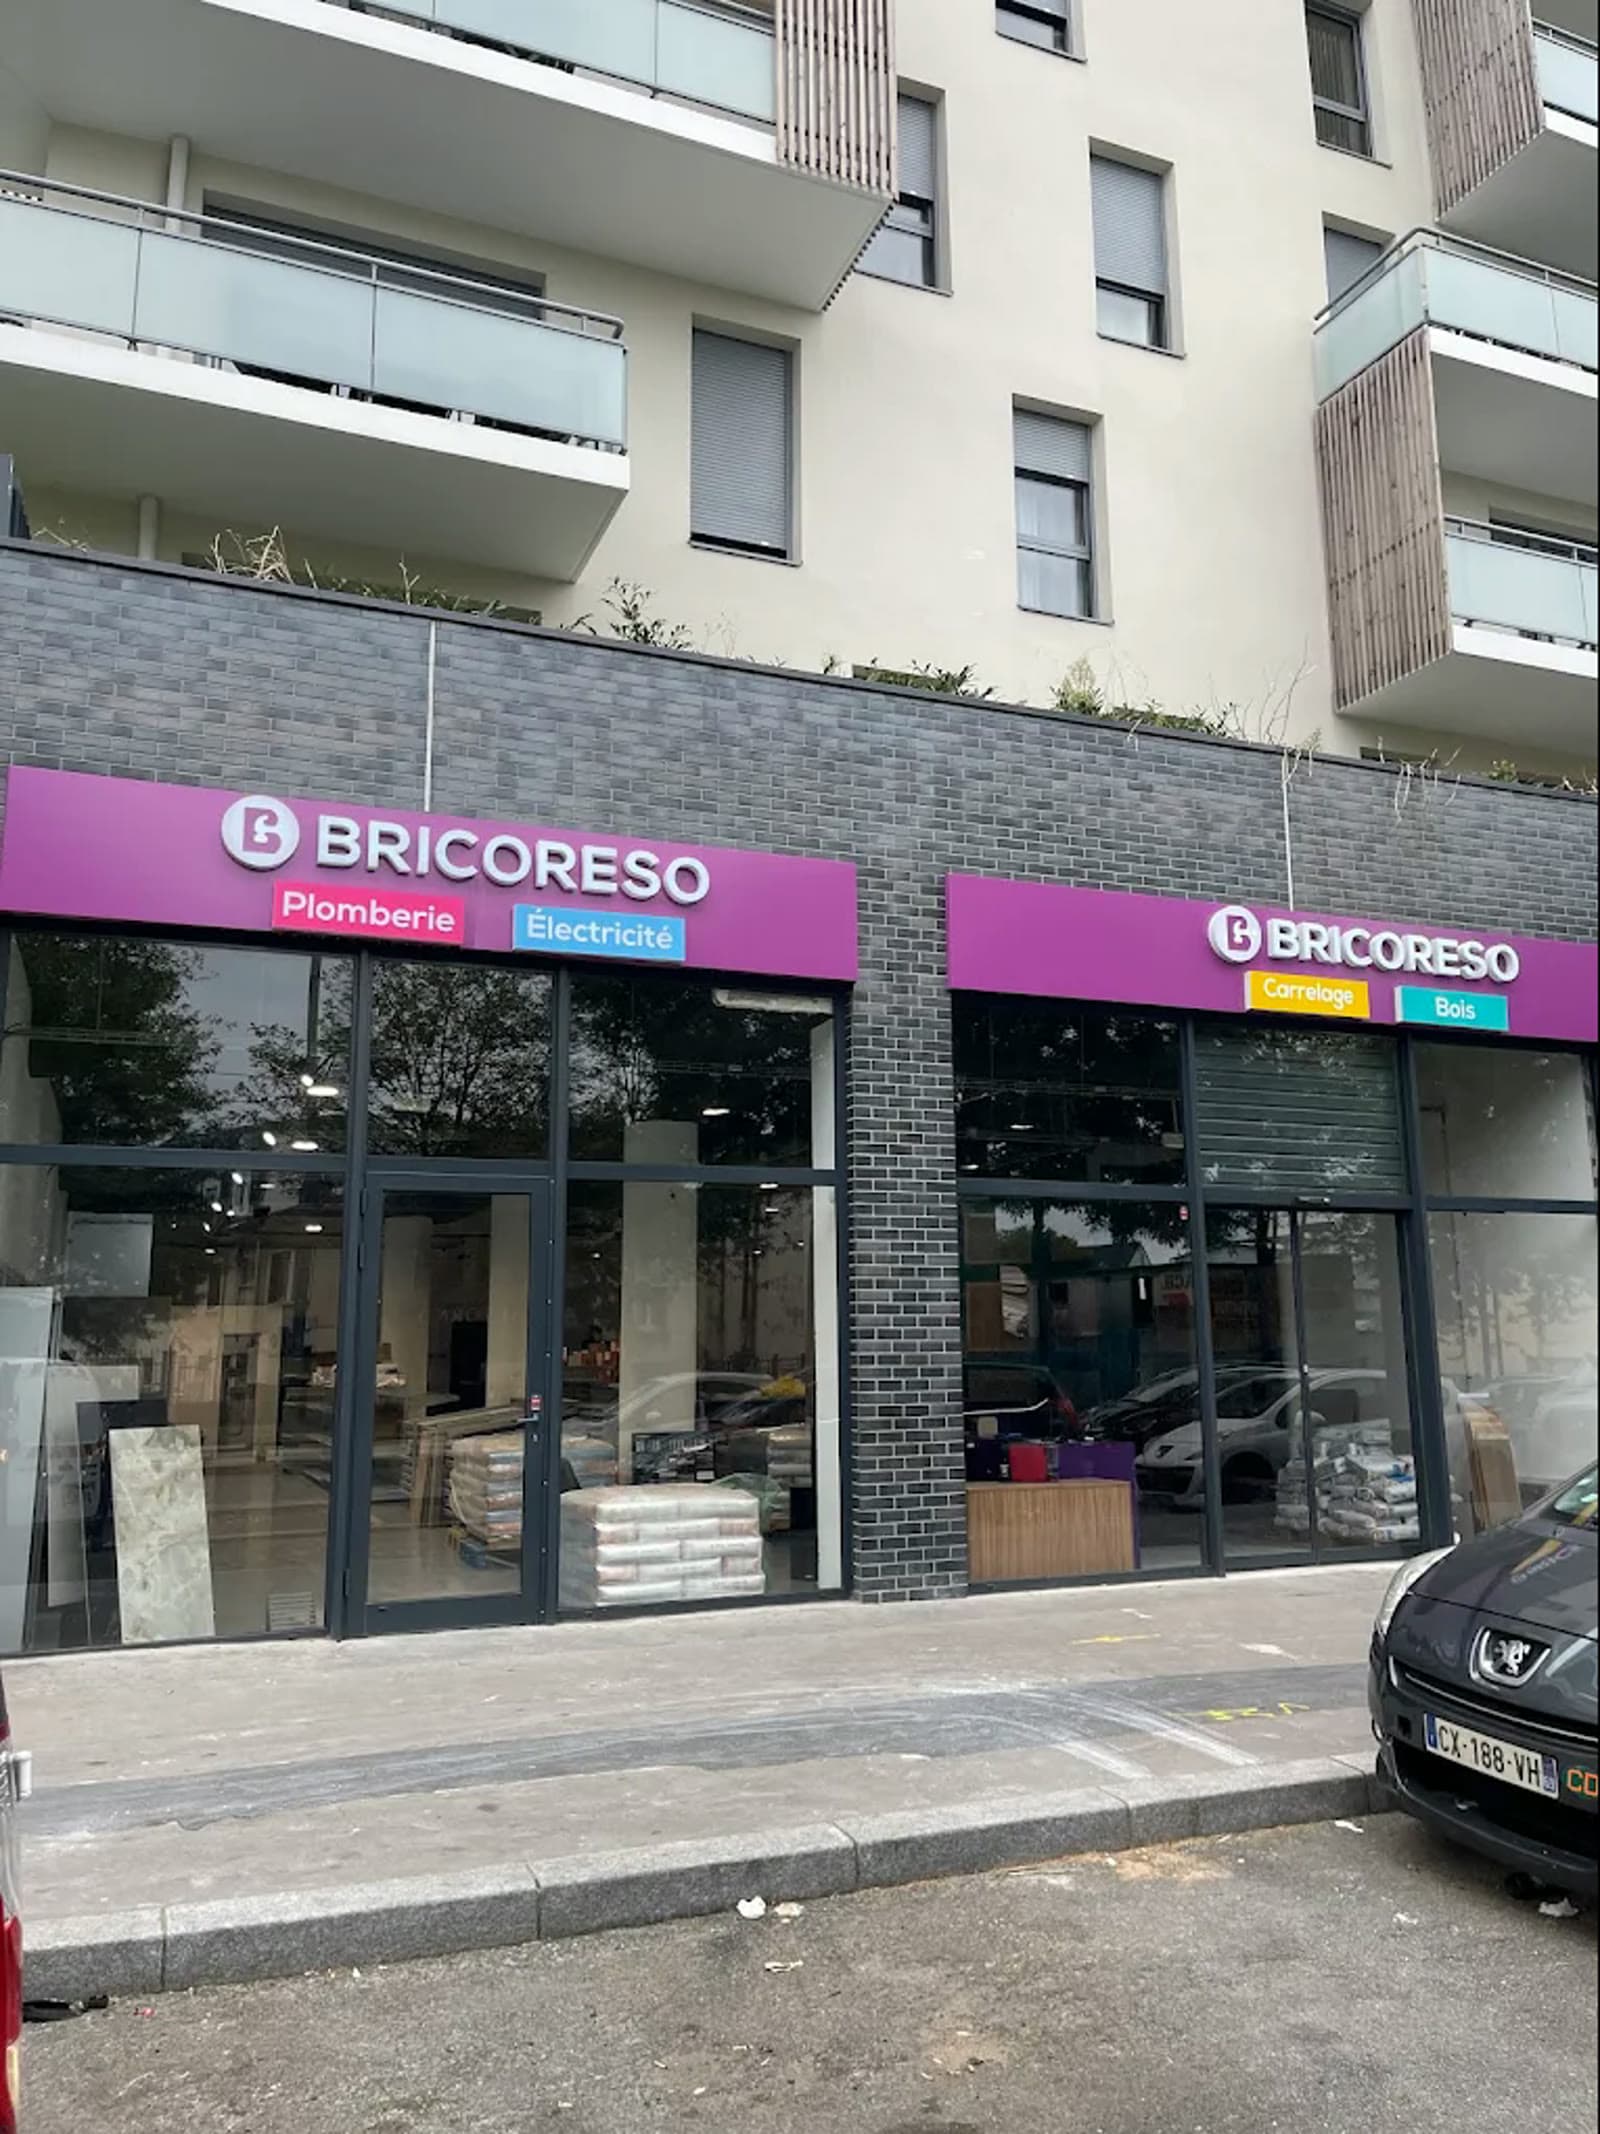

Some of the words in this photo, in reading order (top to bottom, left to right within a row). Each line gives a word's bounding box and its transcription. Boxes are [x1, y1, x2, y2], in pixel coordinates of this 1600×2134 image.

[317, 813, 711, 905] BRICORESO
[282, 891, 456, 932] Plomberie
[526, 907, 674, 950] Électricité
[1266, 917, 1520, 983] BRICORESO
[1262, 977, 1355, 1010] Carrelage
[1435, 996, 1476, 1021] Bois
[1438, 1724, 1541, 1788] CX-188-VH
